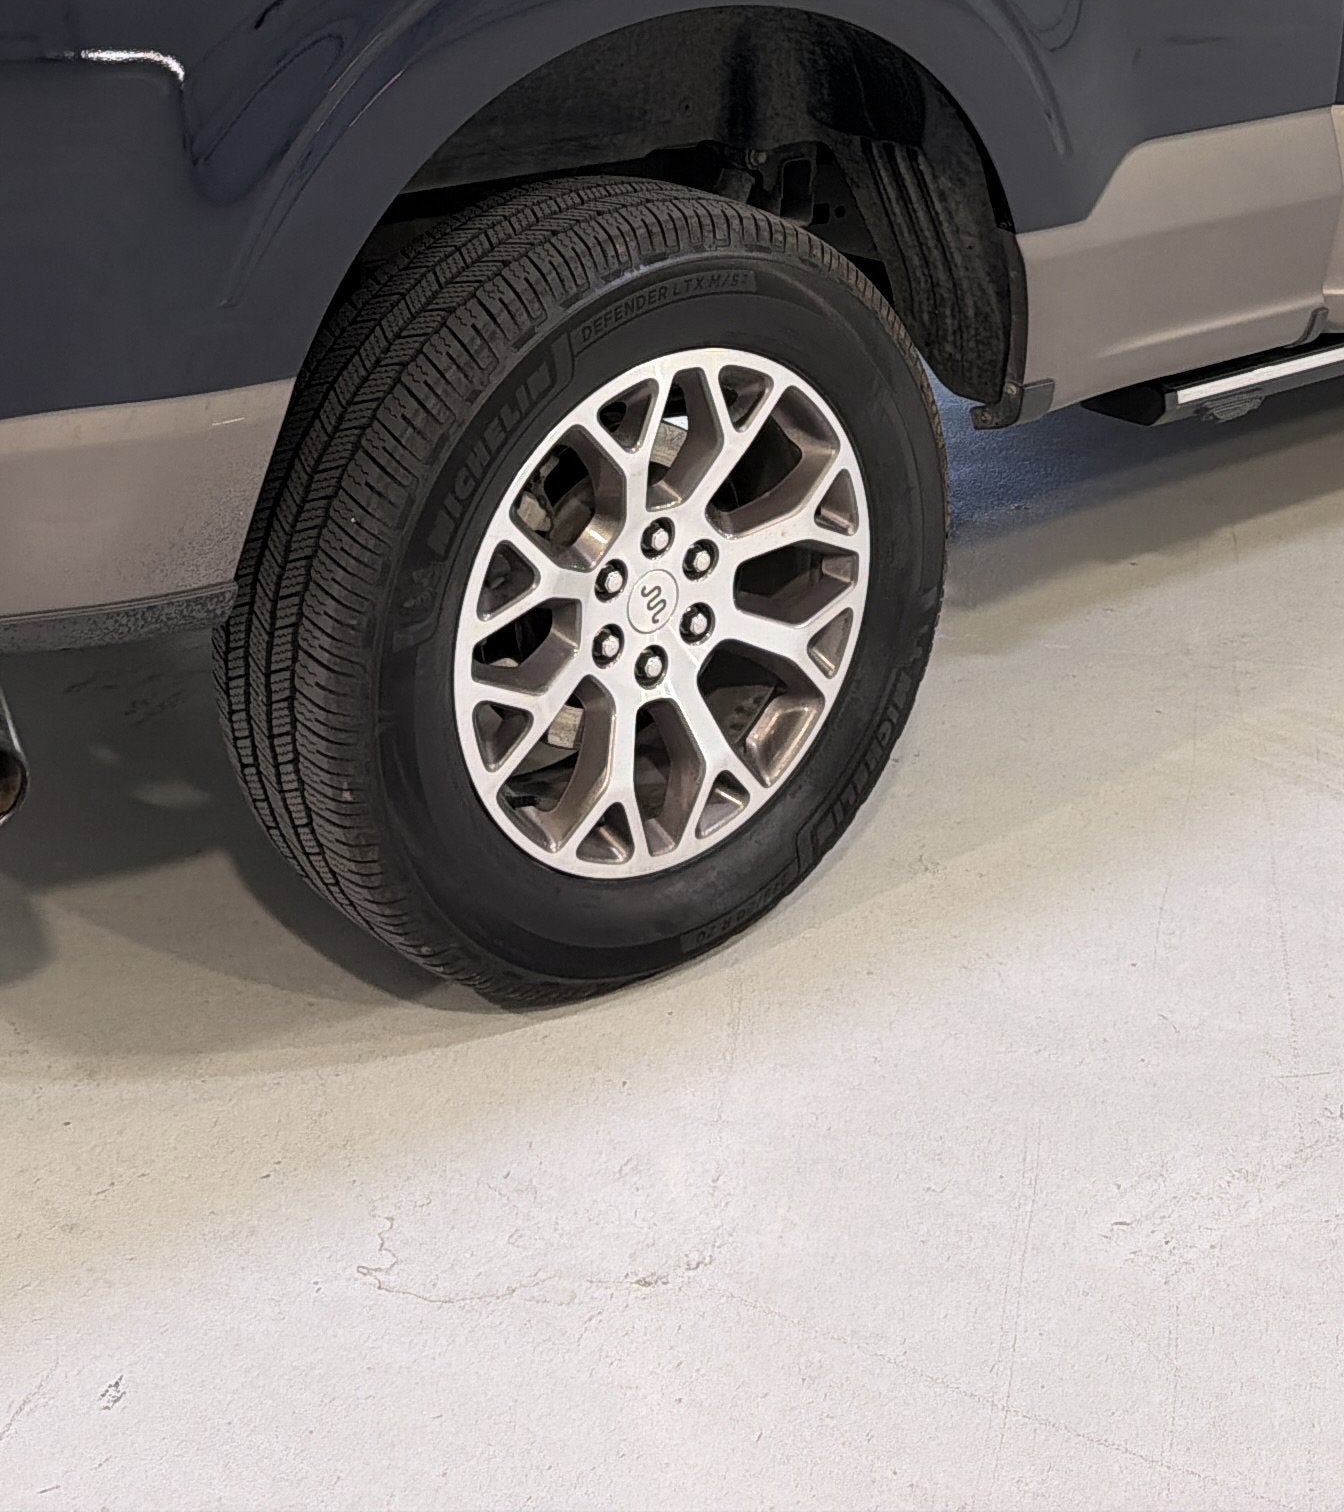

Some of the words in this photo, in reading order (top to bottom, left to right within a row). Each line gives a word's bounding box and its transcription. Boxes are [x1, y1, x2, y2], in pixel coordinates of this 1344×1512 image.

[580, 286, 668, 344] DEFENDER
[672, 278, 704, 297] LTX
[426, 360, 553, 558] MICHELIN
